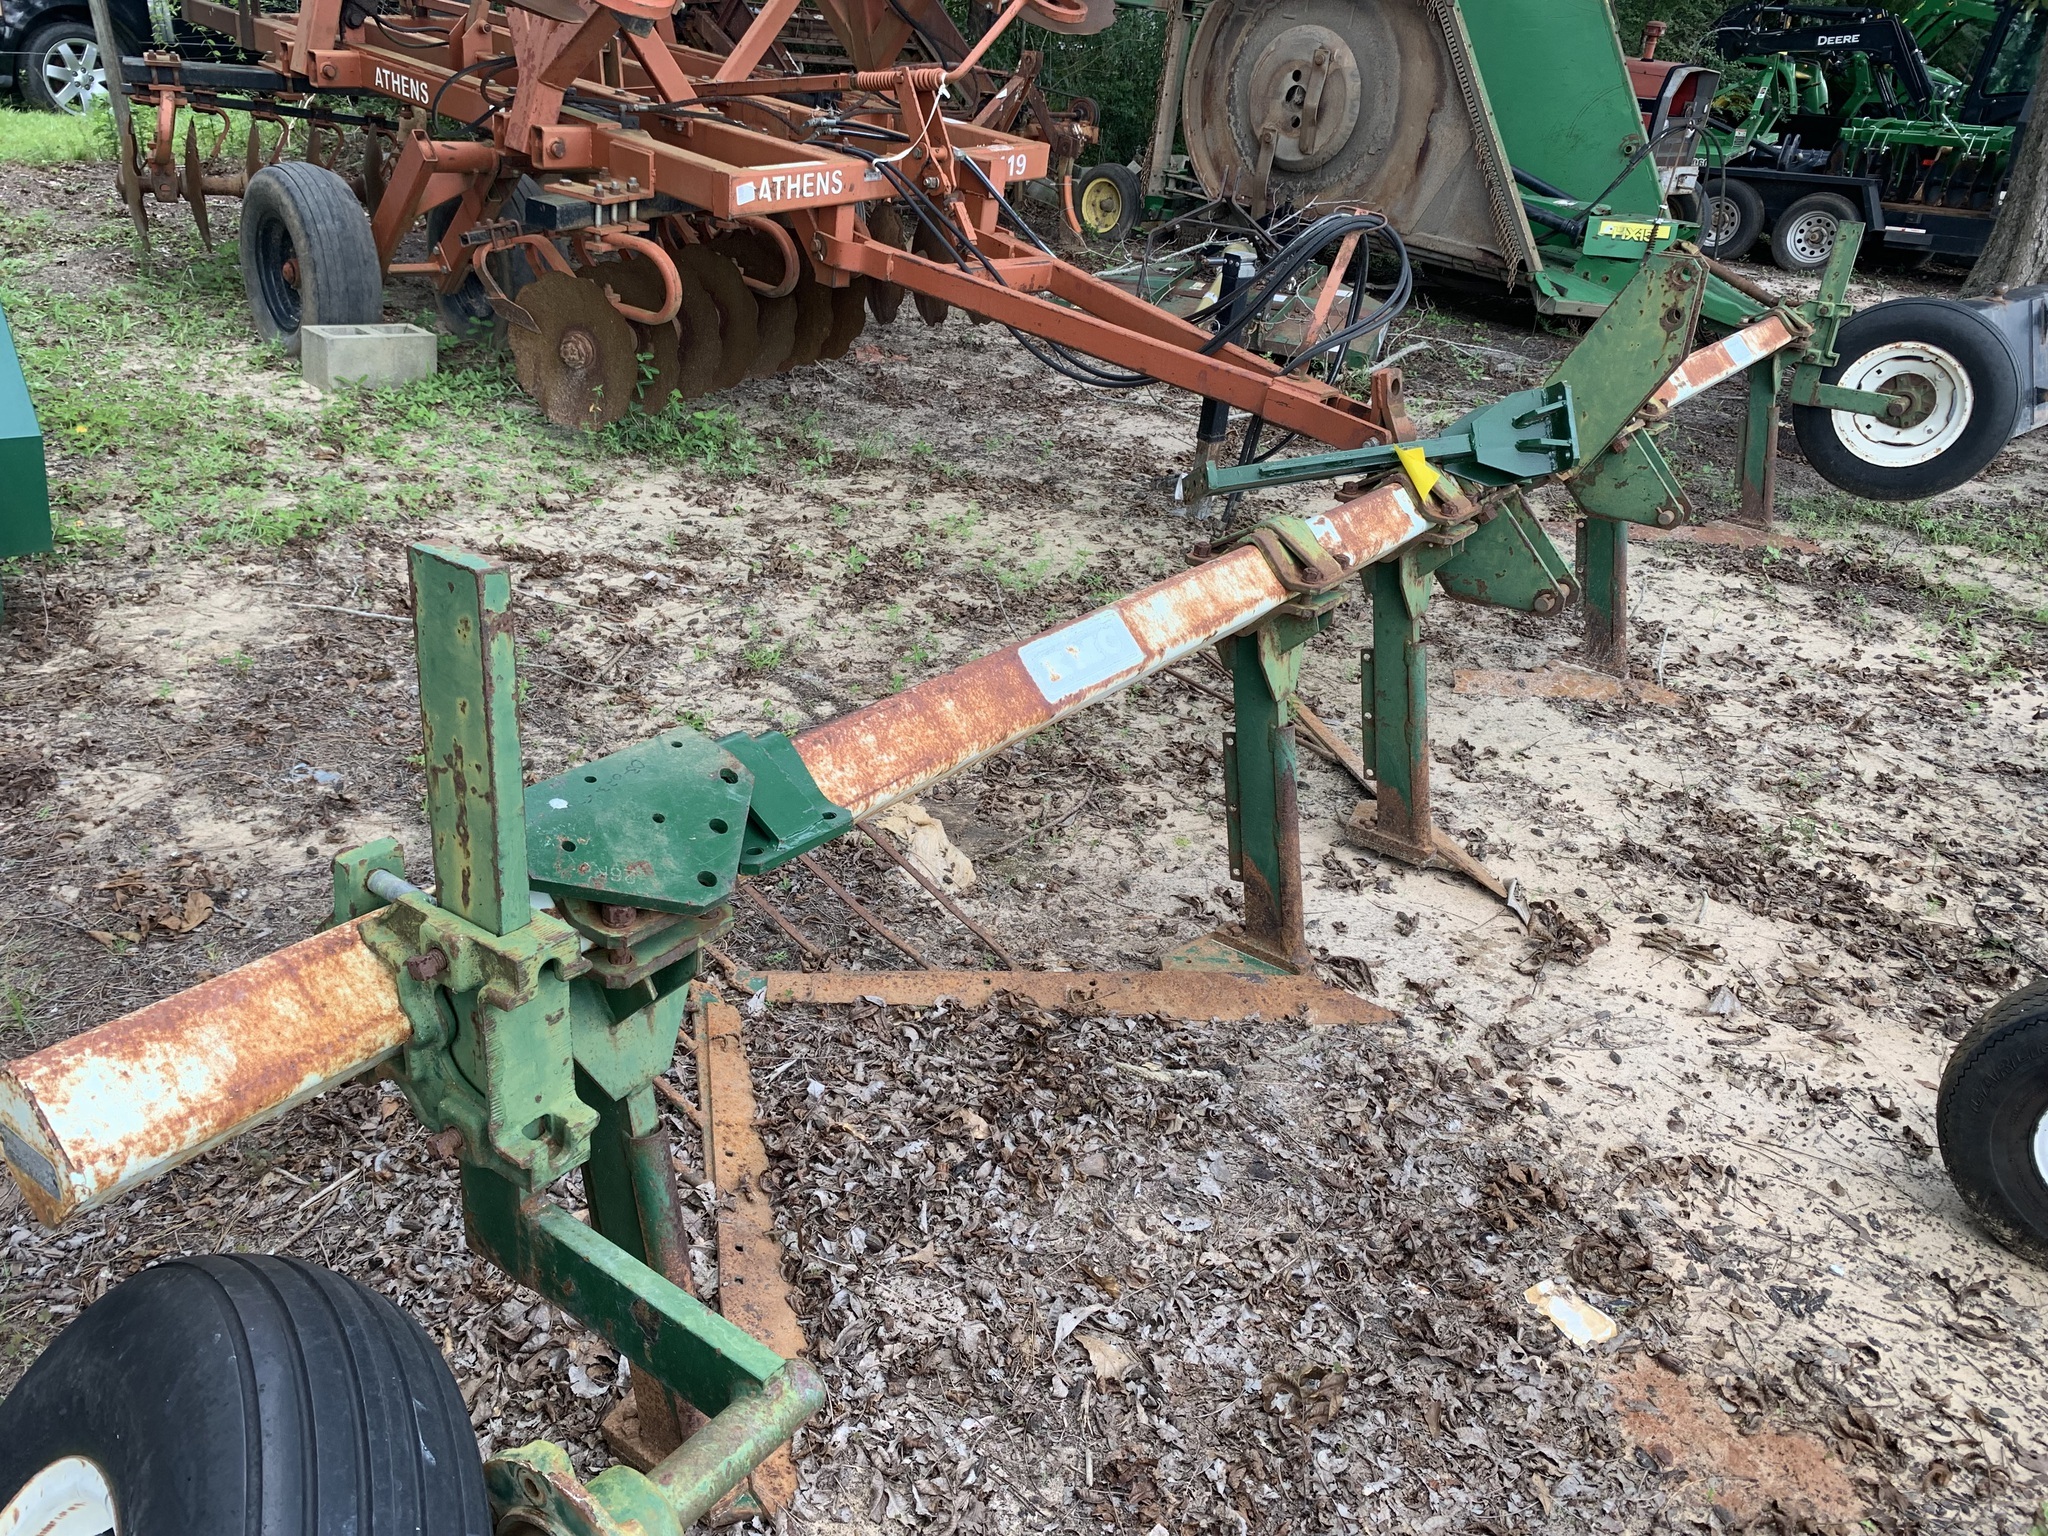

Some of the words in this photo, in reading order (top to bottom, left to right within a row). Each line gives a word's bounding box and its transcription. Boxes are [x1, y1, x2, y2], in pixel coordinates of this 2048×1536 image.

[1817, 34, 1861, 46] DEERE
[375, 66, 429, 104] ATHENS
[1001, 153, 1027, 177] 19
[758, 169, 843, 202] ATHENS
[1610, 226, 1653, 242] HX15
